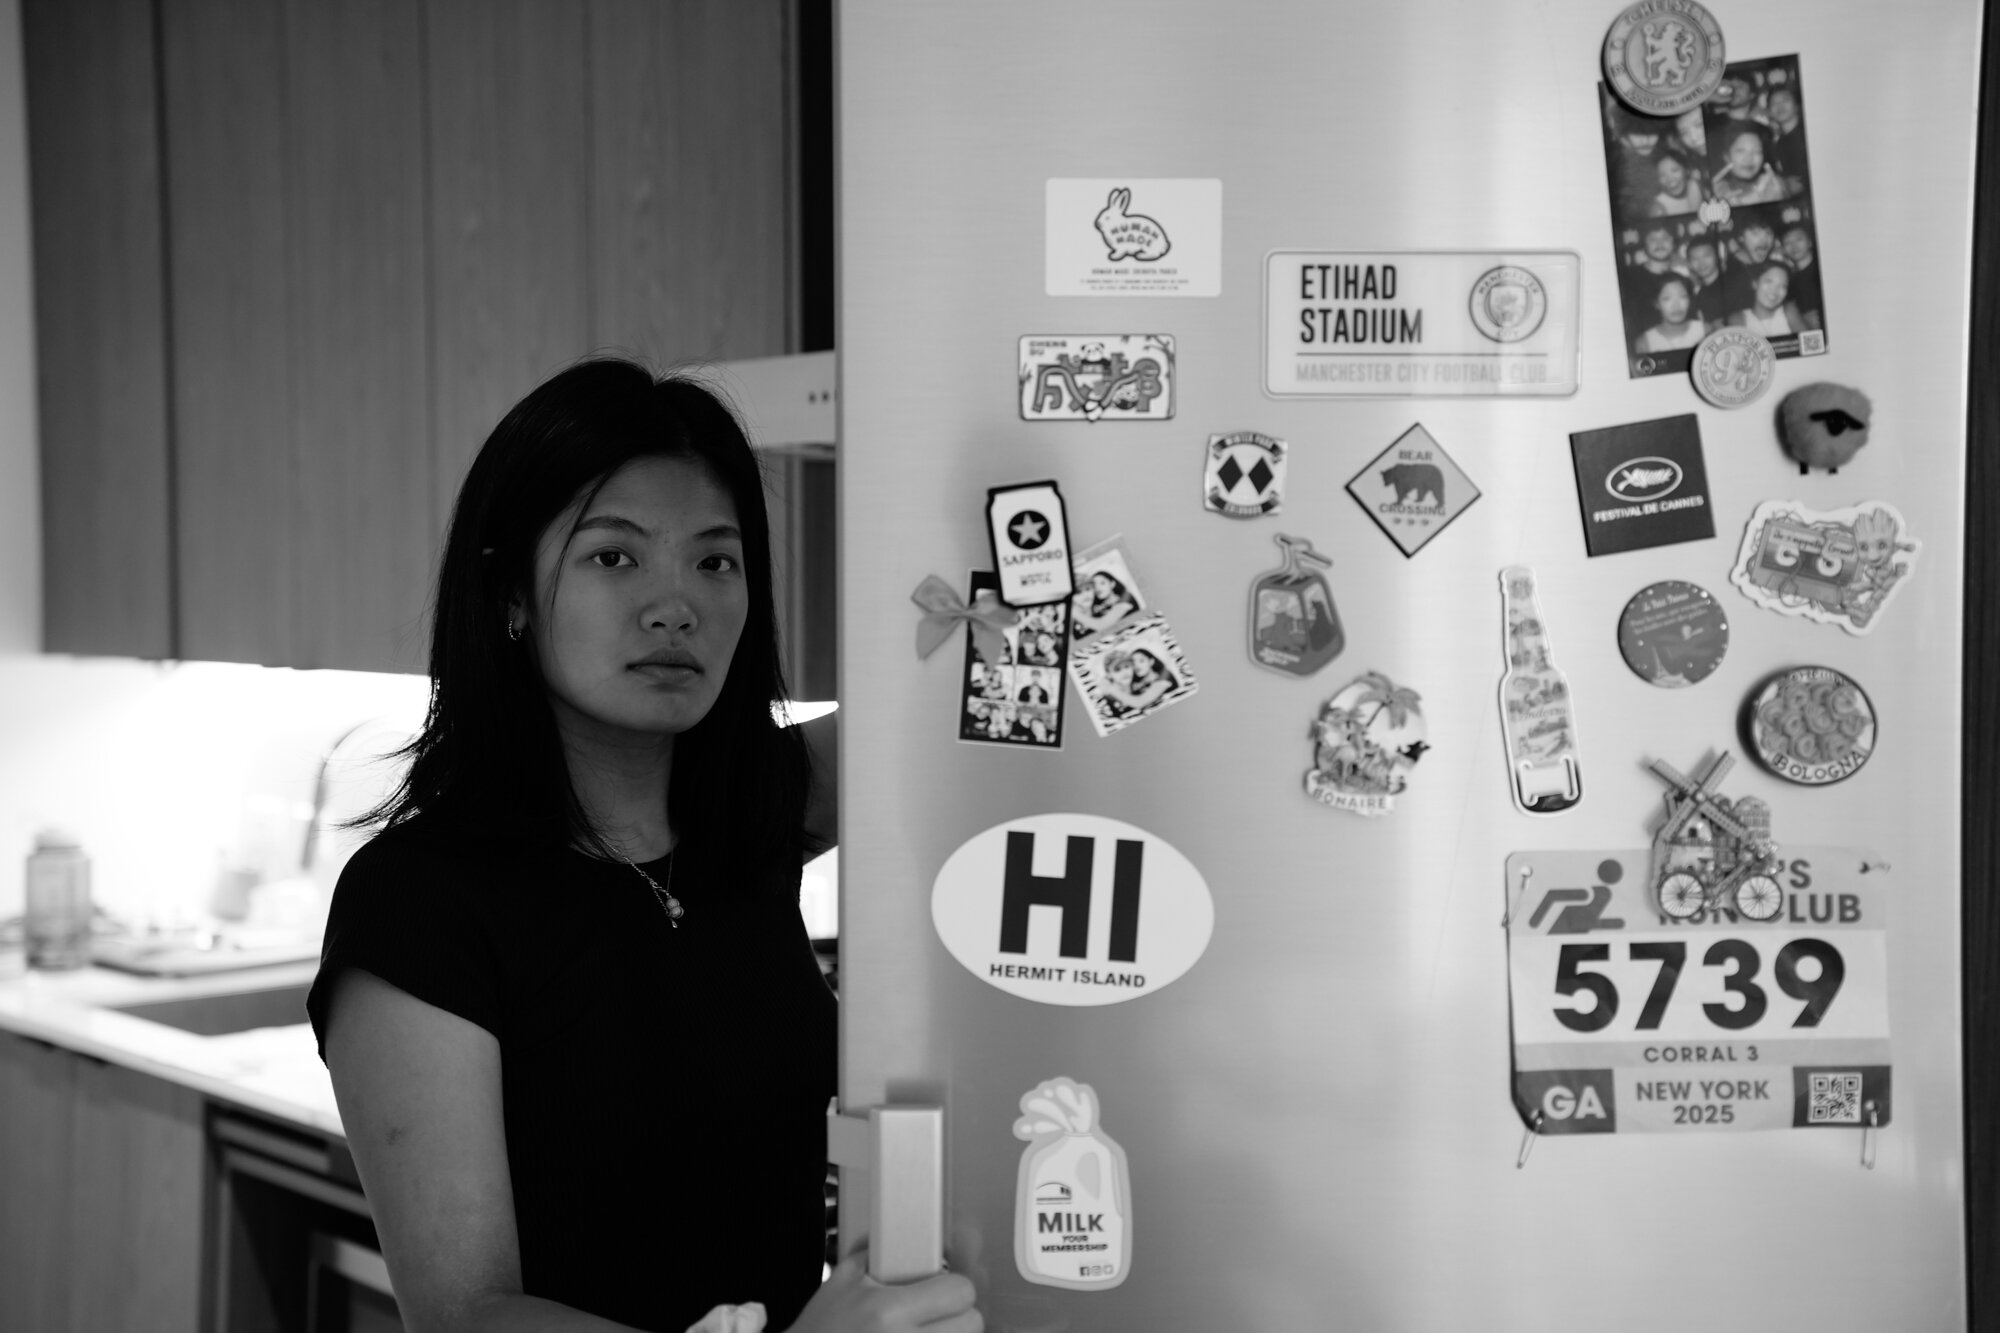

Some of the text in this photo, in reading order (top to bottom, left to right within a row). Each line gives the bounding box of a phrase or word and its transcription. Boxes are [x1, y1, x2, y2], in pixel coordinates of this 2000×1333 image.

[1301, 264, 1397, 300] ETIHAD
[1300, 308, 1423, 344] STADIUM
[1296, 362, 1547, 384] MANCHESTER CITY FOOTBALL CLUB
[1399, 450, 1433, 461] BEAR
[1379, 503, 1447, 517] CROSSING
[1593, 495, 1704, 523] FESTIVAL DE CANNES
[1003, 550, 1063, 566] SAPPORO
[1772, 751, 1866, 780] BOLOGNA
[1000, 830, 1144, 963] HI
[1762, 893, 1862, 924] LUB
[990, 963, 1146, 988] HERMIT ISLAND
[1553, 938, 1846, 1033] 5739
[1643, 1045, 1760, 1063] CORRAL 3
[1636, 1080, 1771, 1101] NEW YORK
[1542, 1084, 1608, 1121] GA
[1673, 1104, 1736, 1125] 2025
[1037, 1211, 1104, 1234] MILK
[1041, 1243, 1109, 1254] MEMBERSHIP
[1062, 1234, 1089, 1244] YOUR
